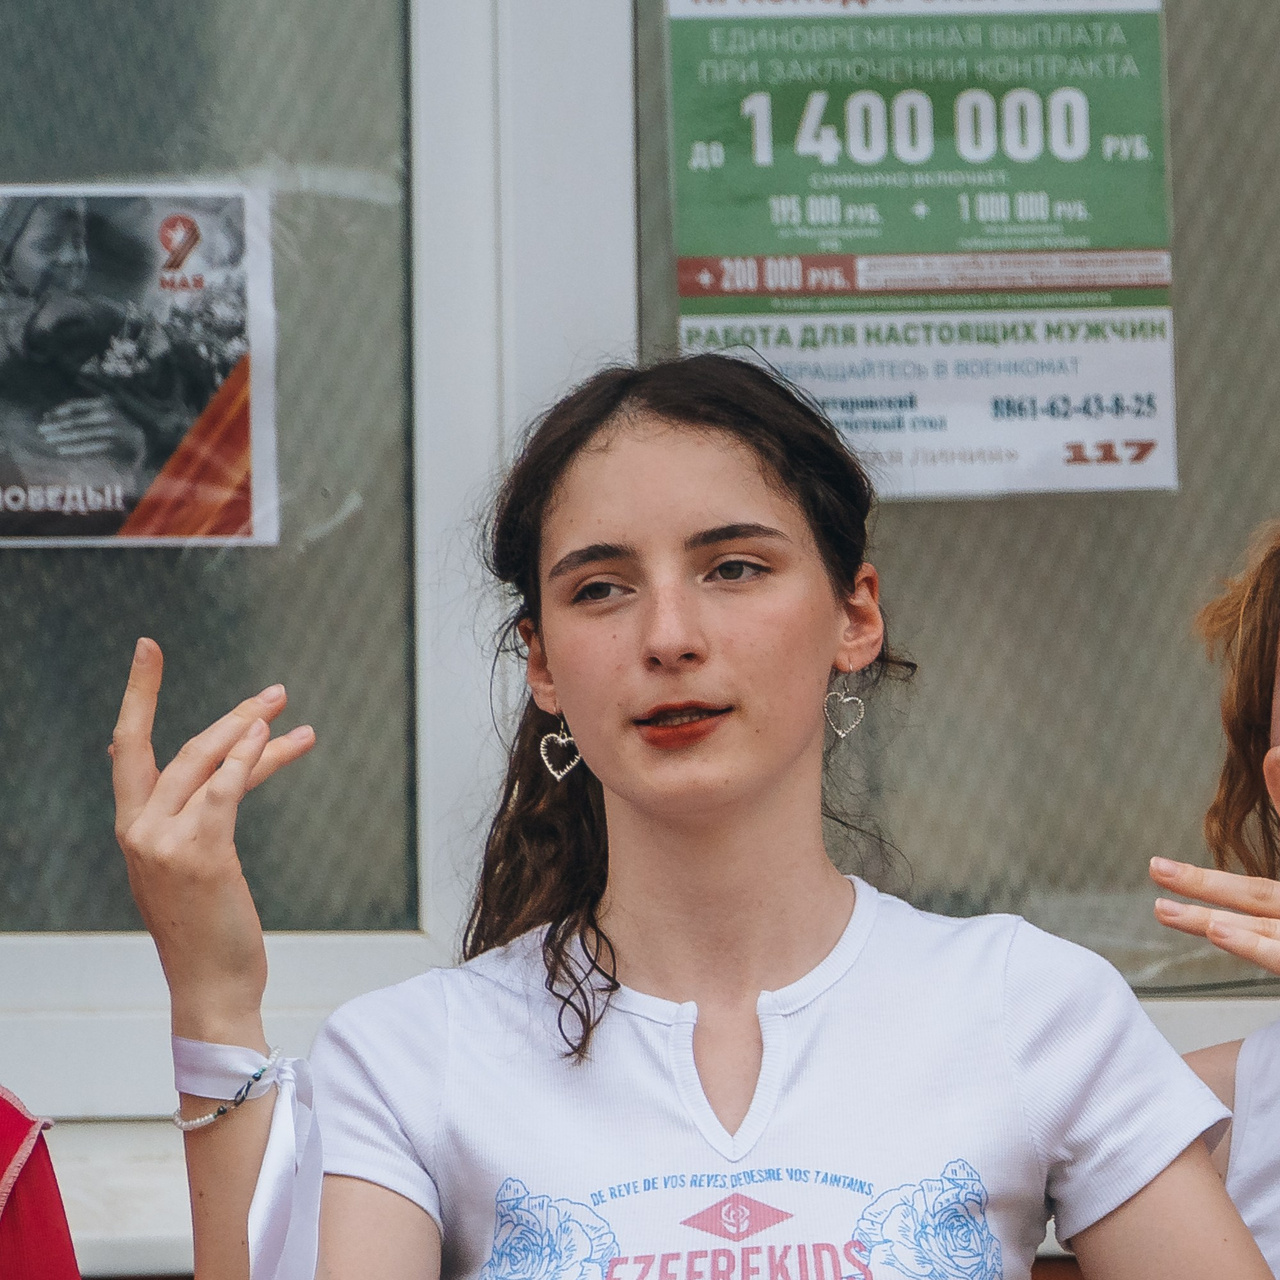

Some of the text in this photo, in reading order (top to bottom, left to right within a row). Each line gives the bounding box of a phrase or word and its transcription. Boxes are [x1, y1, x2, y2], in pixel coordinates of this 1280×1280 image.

[709, 22, 1127, 54] ЕДИНОВРЕМЕННАЯ ВЫПЛАТА
[700, 53, 1140, 86] ПРИ ЗАКЛЮЧЕНИИ КОНТРАКТА
[741, 92, 773, 167] 1
[795, 89, 934, 166] 400
[954, 87, 1090, 164] 000
[158, 213, 200, 271] 9
[684, 317, 1167, 349] РАБОТА ДЛЯ НАСТОЯЩИХ МУЖЧИН
[1065, 439, 1157, 465] 117
[0, 484, 124, 516] ОБЕДЫ!
[590, 1190, 607, 1206] DE
[608, 1181, 640, 1200] REVE
[643, 1177, 659, 1192] DE
[663, 1174, 686, 1189] VOS
[785, 1167, 811, 1183] VOS
